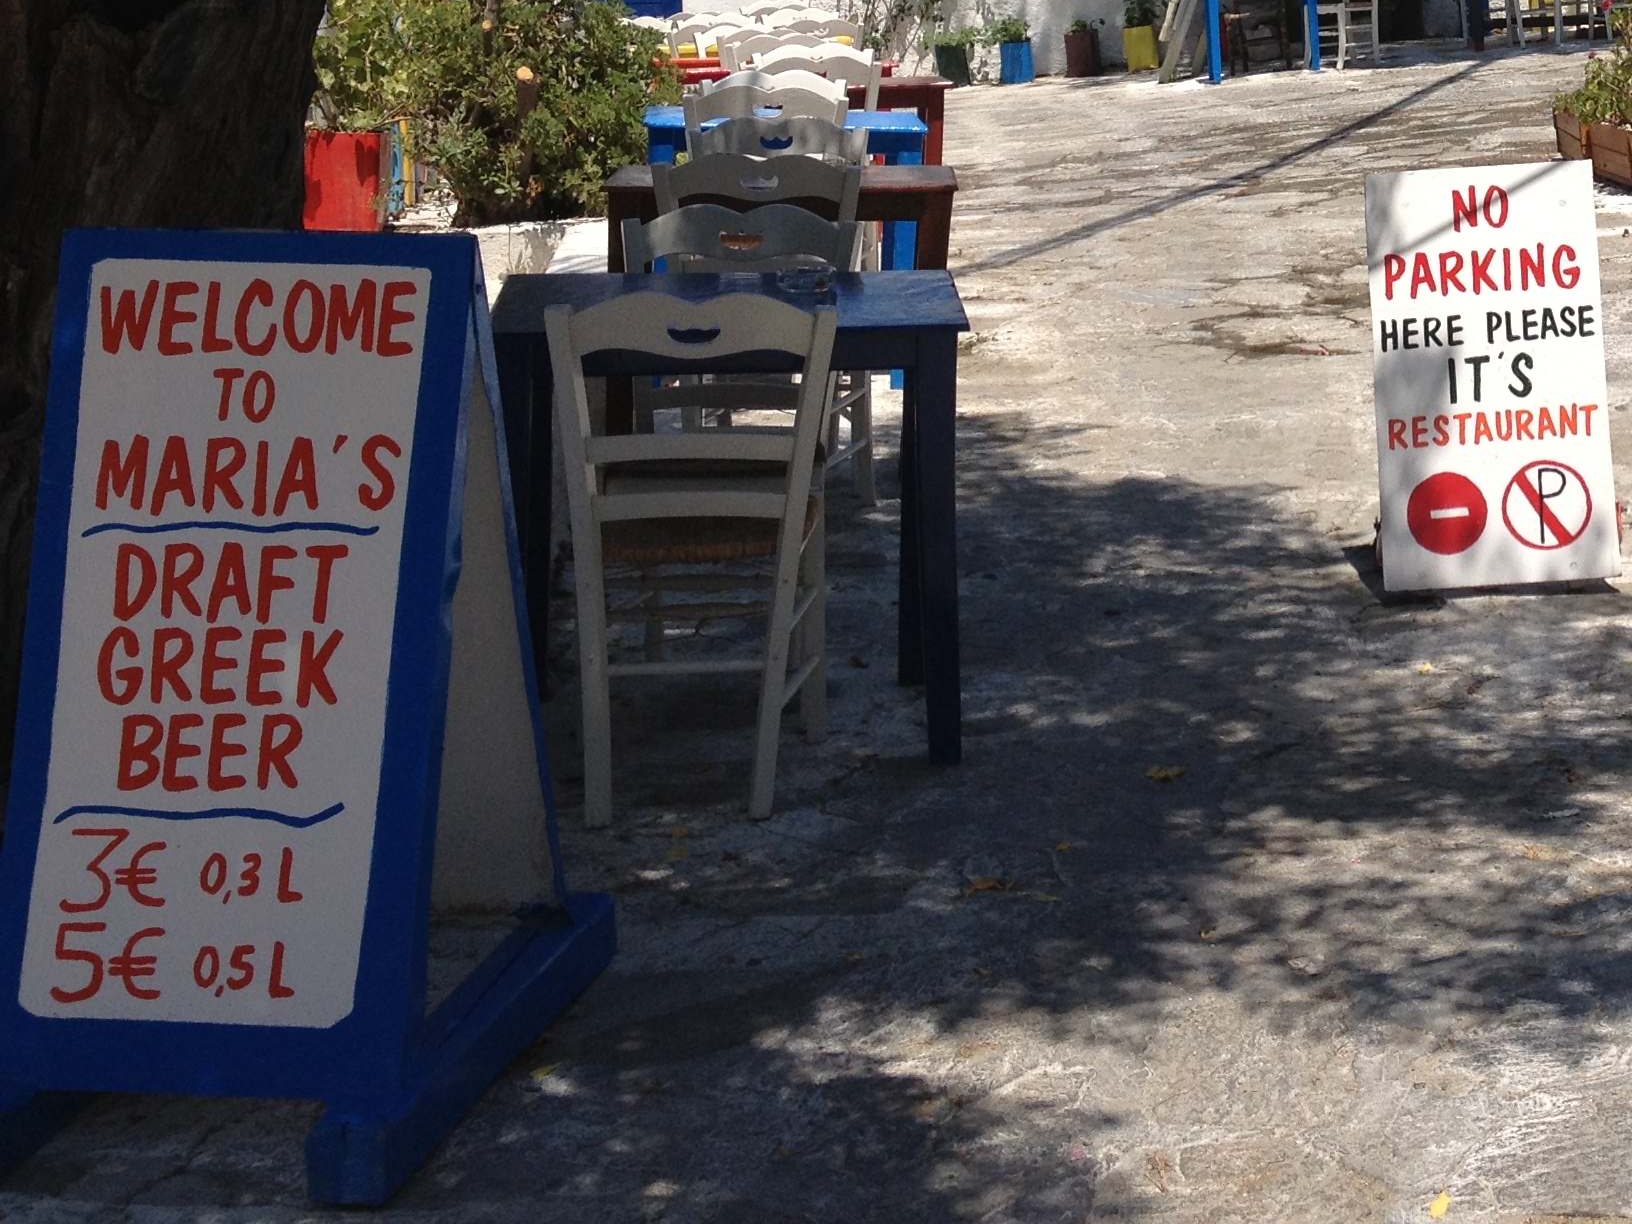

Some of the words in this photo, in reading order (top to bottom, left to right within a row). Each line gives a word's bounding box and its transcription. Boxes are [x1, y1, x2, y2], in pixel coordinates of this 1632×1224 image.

[1451, 184, 1508, 233] NO
[1383, 242, 1581, 301] PARKING
[100, 278, 417, 357] WELCOME
[1380, 313, 1465, 353] HERE
[1486, 304, 1596, 345] PLEASE
[213, 367, 276, 423] TO
[1447, 351, 1534, 405] IT'S
[1388, 403, 1599, 451] RESTAURANT
[95, 434, 402, 517] MARIA'S
[113, 541, 349, 625] DRAFT
[96, 625, 345, 708] GREEK
[117, 713, 303, 792] BEER
[59, 827, 168, 914] 3€
[50, 921, 166, 1004] 5€
